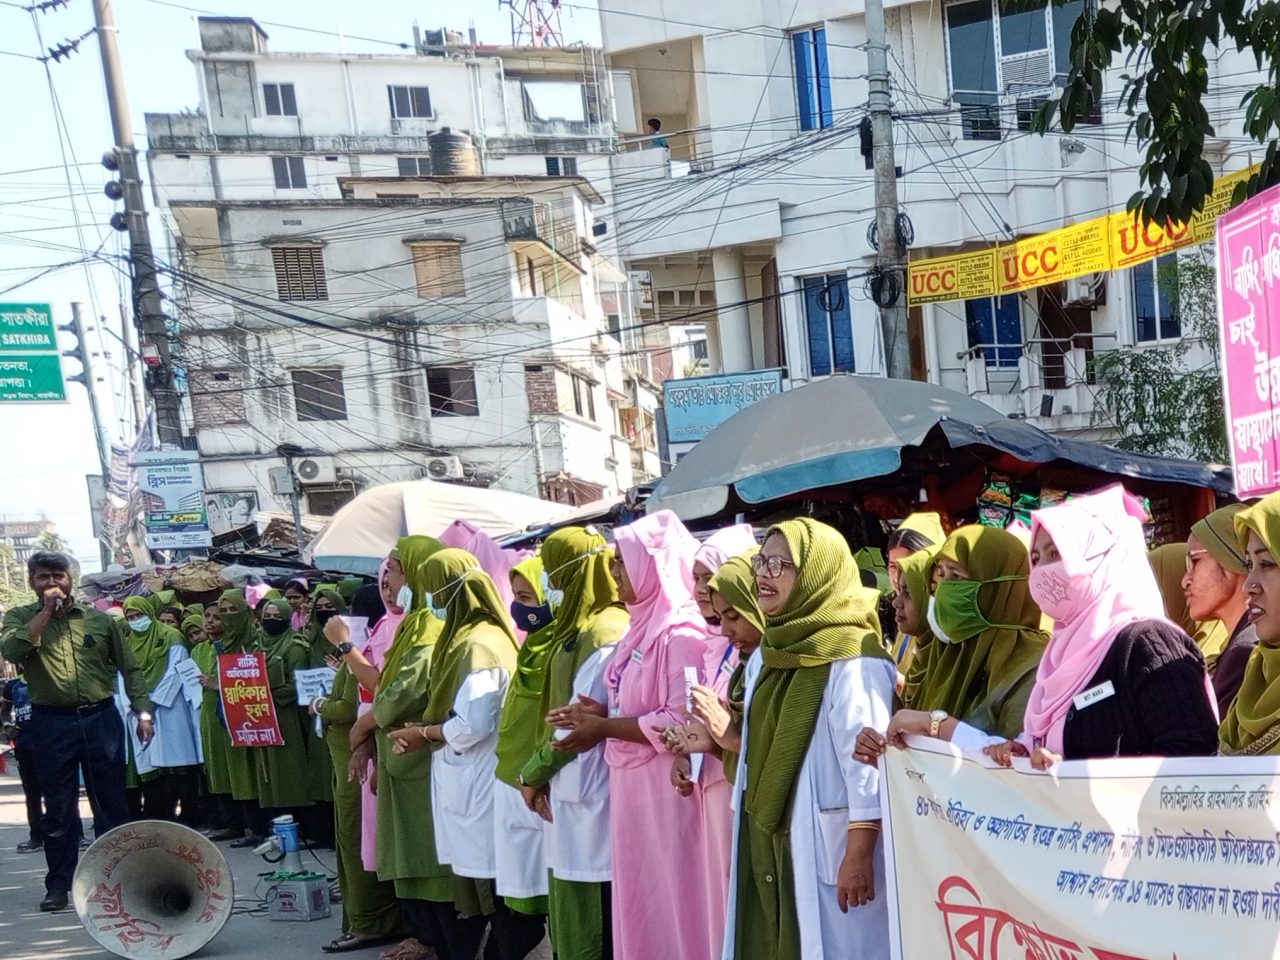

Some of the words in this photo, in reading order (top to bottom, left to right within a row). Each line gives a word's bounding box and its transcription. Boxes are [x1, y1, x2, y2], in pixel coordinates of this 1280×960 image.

[912, 269, 956, 295] UCC
[1003, 245, 1059, 283] UCC
[1233, 245, 1262, 299] নার্সিং
[2, 334, 51, 345] SATKHIRA
[1229, 301, 1259, 346] চাই
[1160, 785, 1205, 812] বিসমিল্লাহির
[974, 815, 986, 831] ও
[1057, 821, 1082, 853] নার্সিং
[1147, 836, 1155, 856] ও
[1154, 827, 1216, 862] মিডওয়াইফারি
[1128, 880, 1144, 905] ১৪
[1145, 880, 1174, 909] মাসেও
[1177, 881, 1218, 914] বাস্তবায়ন
[1218, 884, 1231, 916] না
[1232, 886, 1259, 919] হওয়া
